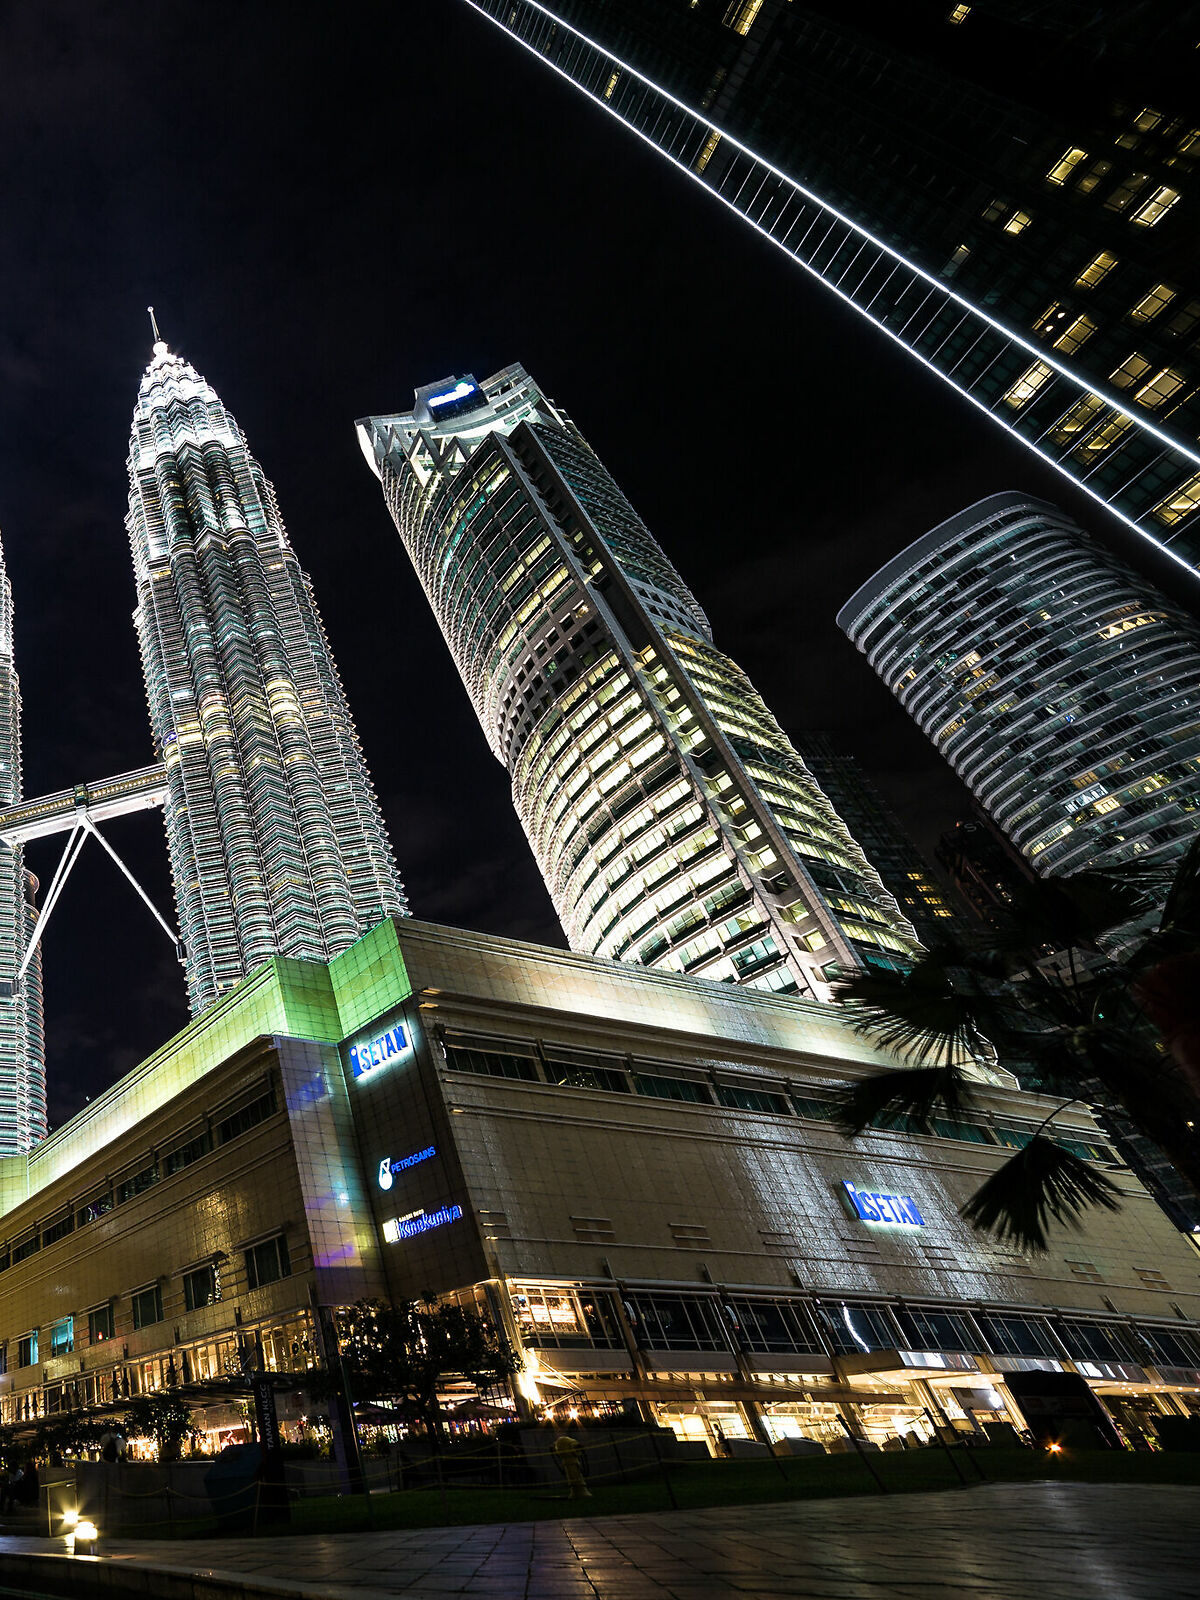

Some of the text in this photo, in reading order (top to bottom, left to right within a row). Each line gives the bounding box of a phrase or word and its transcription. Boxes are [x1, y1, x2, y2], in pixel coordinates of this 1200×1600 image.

[391, 1146, 436, 1173] PETROSAINS
[399, 1205, 462, 1238] Kinokuniya
[260, 1384, 270, 1411] KLCC
[264, 1413, 274, 1450] TAMAN
